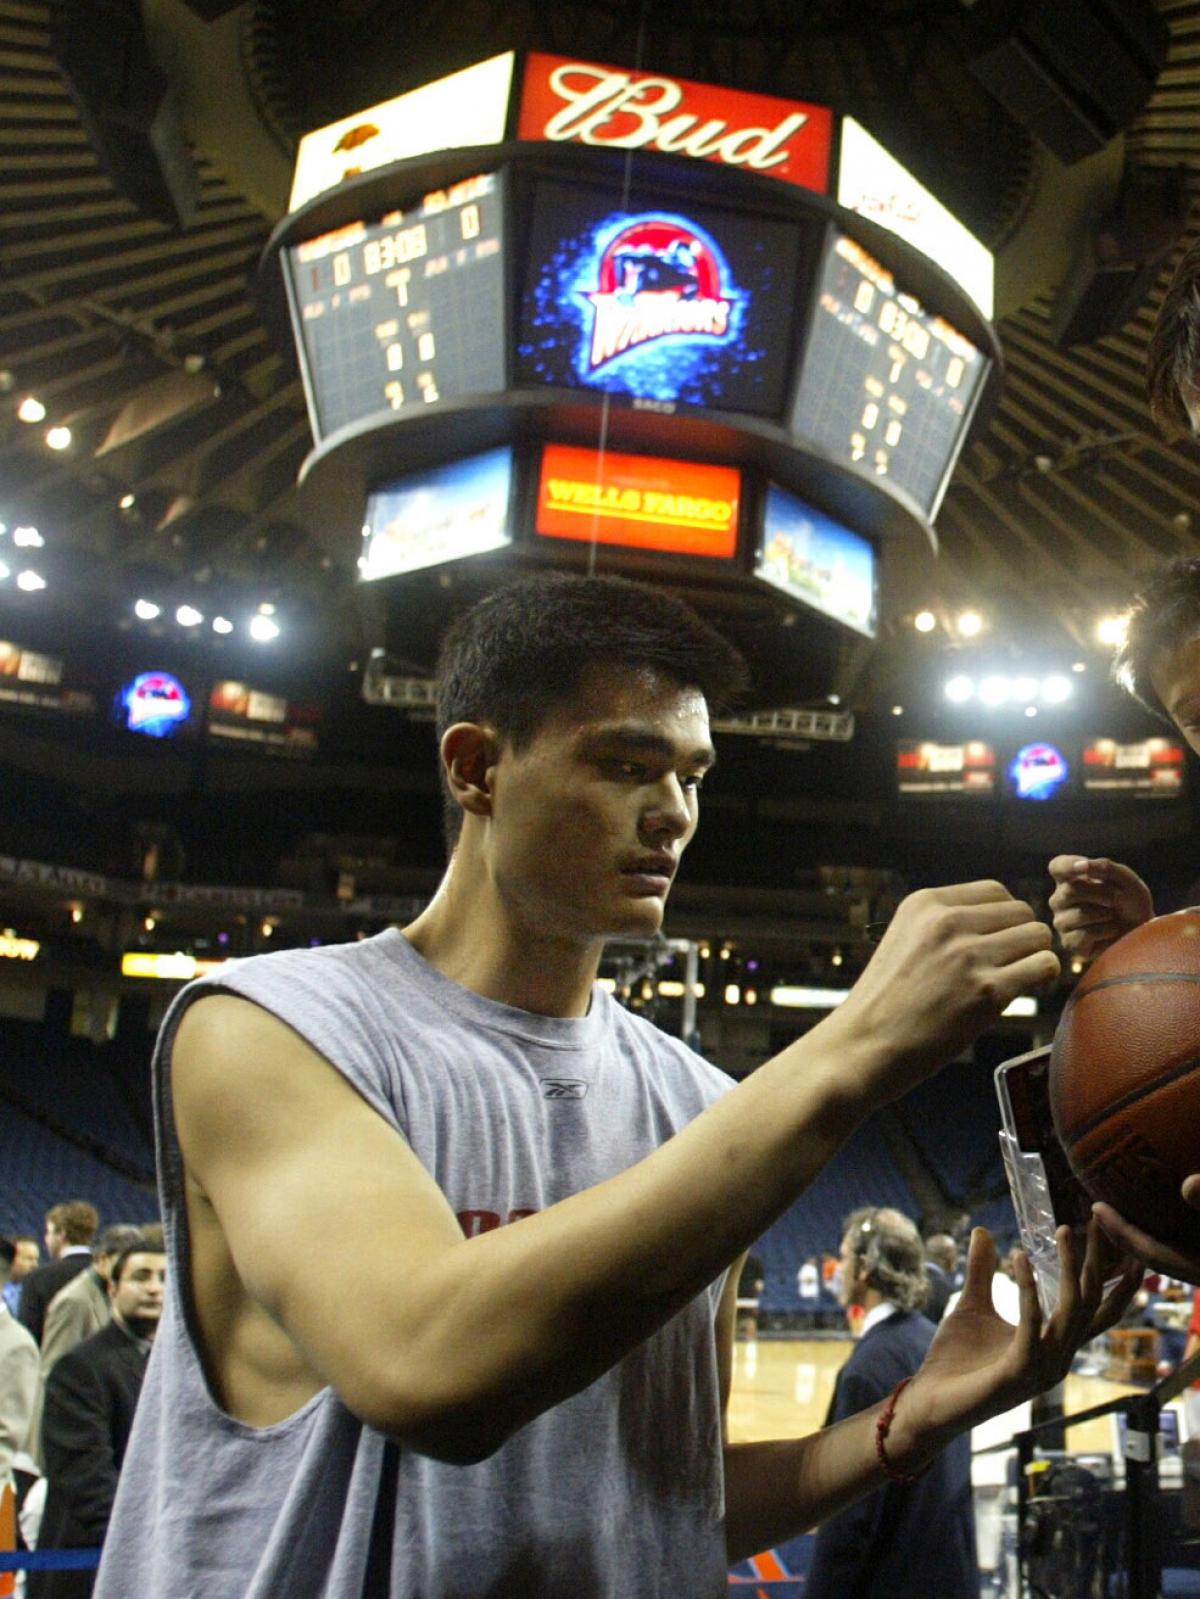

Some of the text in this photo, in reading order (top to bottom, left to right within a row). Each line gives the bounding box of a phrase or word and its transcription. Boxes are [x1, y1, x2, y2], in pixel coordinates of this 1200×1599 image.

[545, 64, 808, 168] Bud
[548, 479, 731, 521] WELLS FARGO
